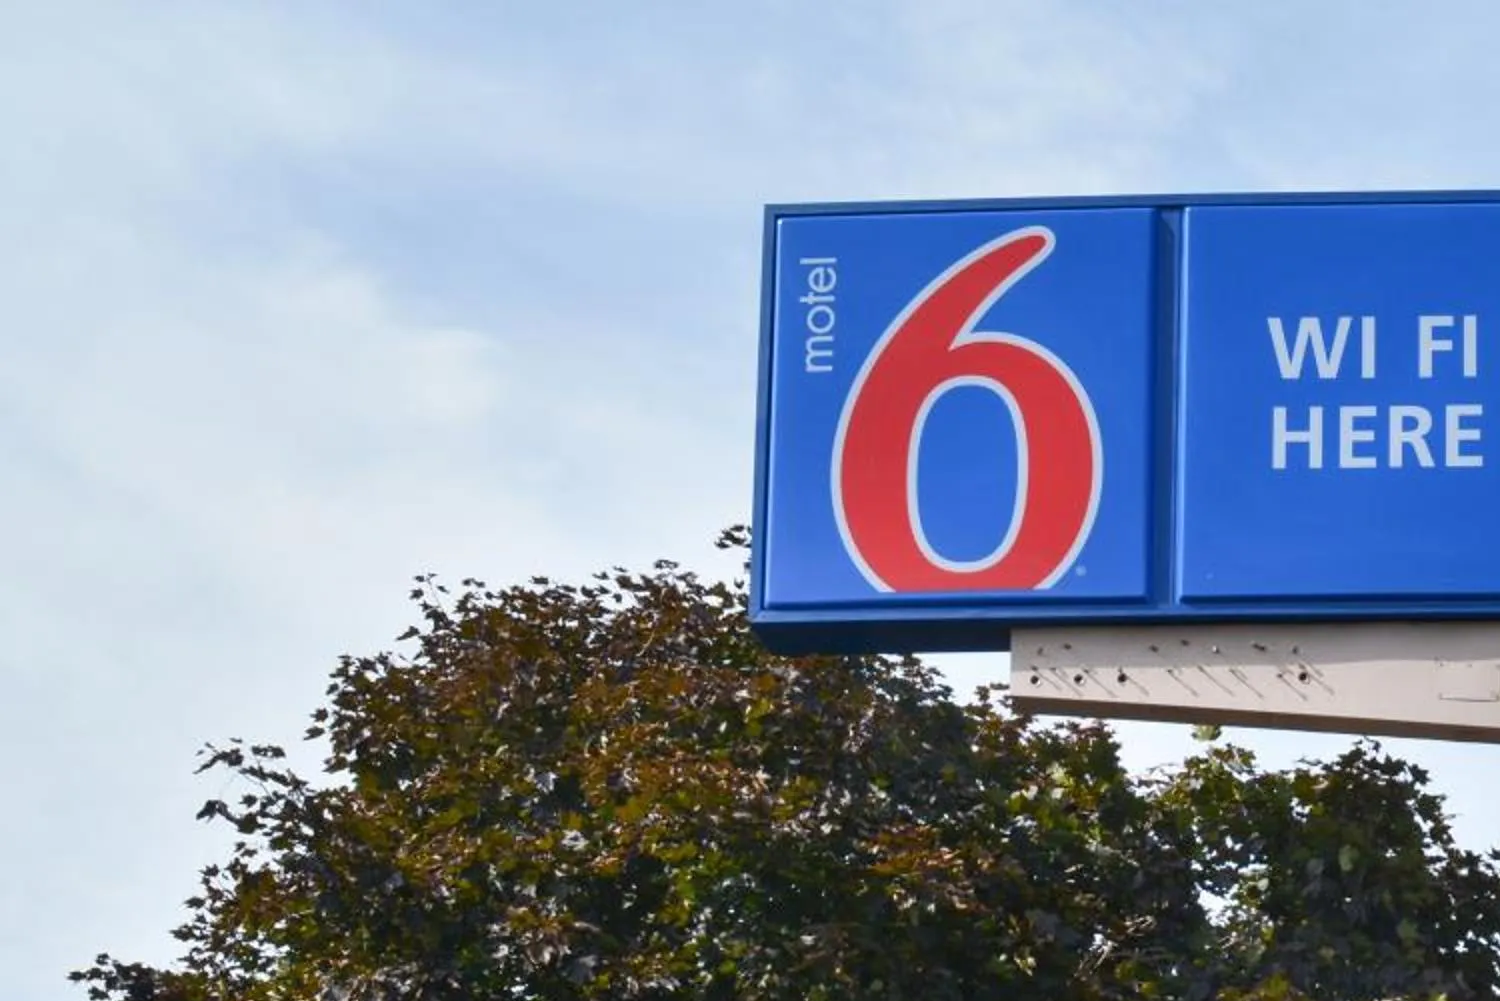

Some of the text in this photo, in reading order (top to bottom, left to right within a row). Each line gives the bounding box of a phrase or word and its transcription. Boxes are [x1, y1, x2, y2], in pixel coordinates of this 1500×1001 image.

[1267, 315, 1477, 380] WI FI
[799, 225, 1104, 594] motel 6
[1272, 404, 1484, 469] HERE
